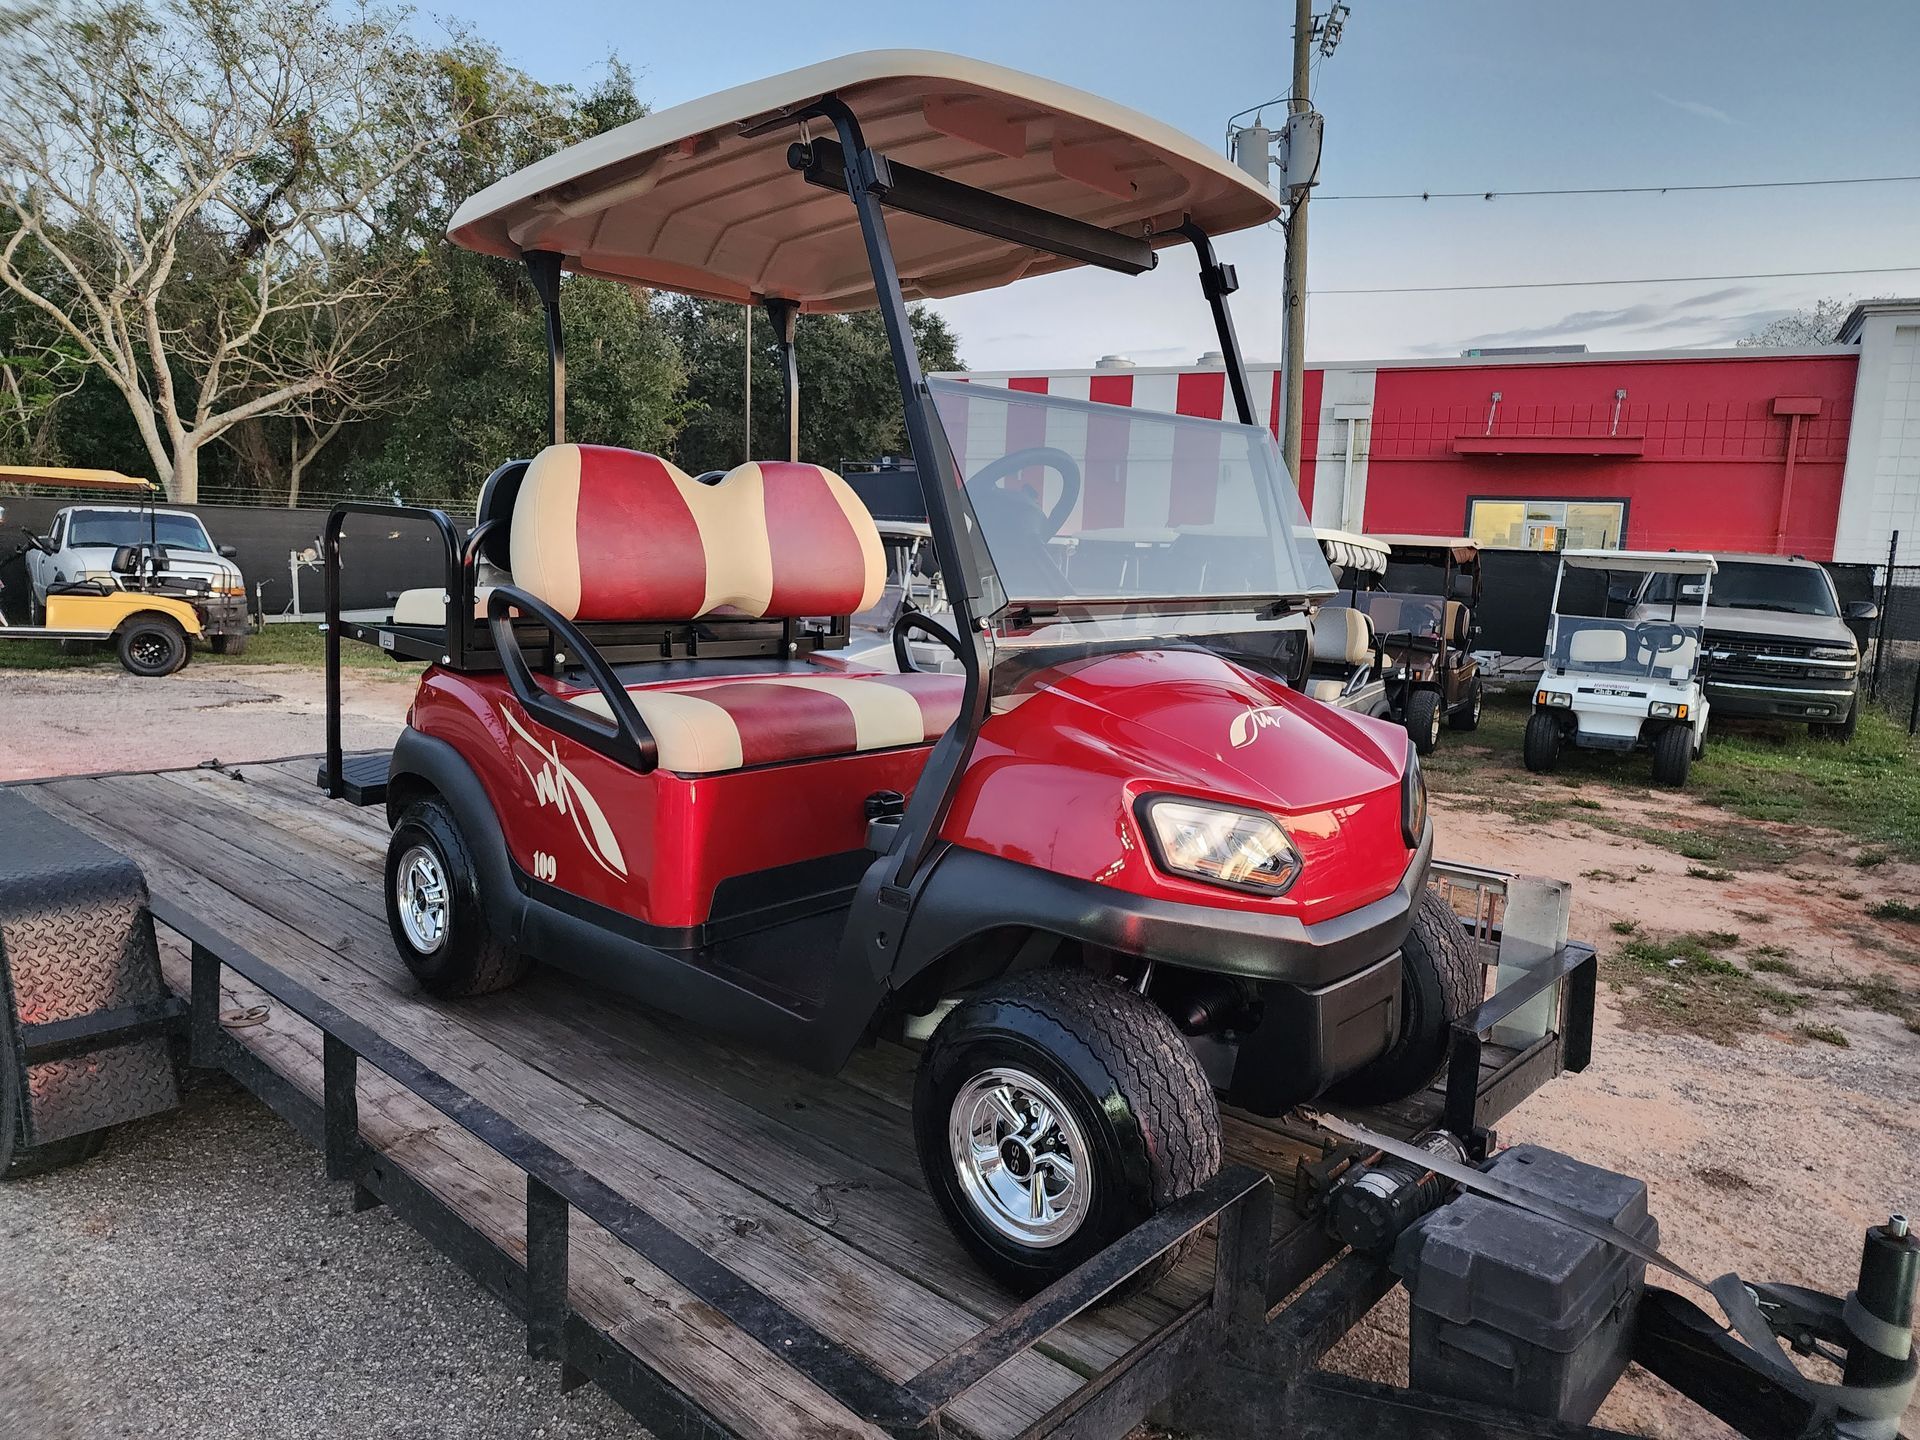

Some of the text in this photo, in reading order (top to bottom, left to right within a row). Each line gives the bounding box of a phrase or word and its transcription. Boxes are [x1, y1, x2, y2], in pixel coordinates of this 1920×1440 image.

[1593, 688, 1631, 698] Club Car
[533, 850, 556, 882] 109
[1011, 1144, 1020, 1173] SS
